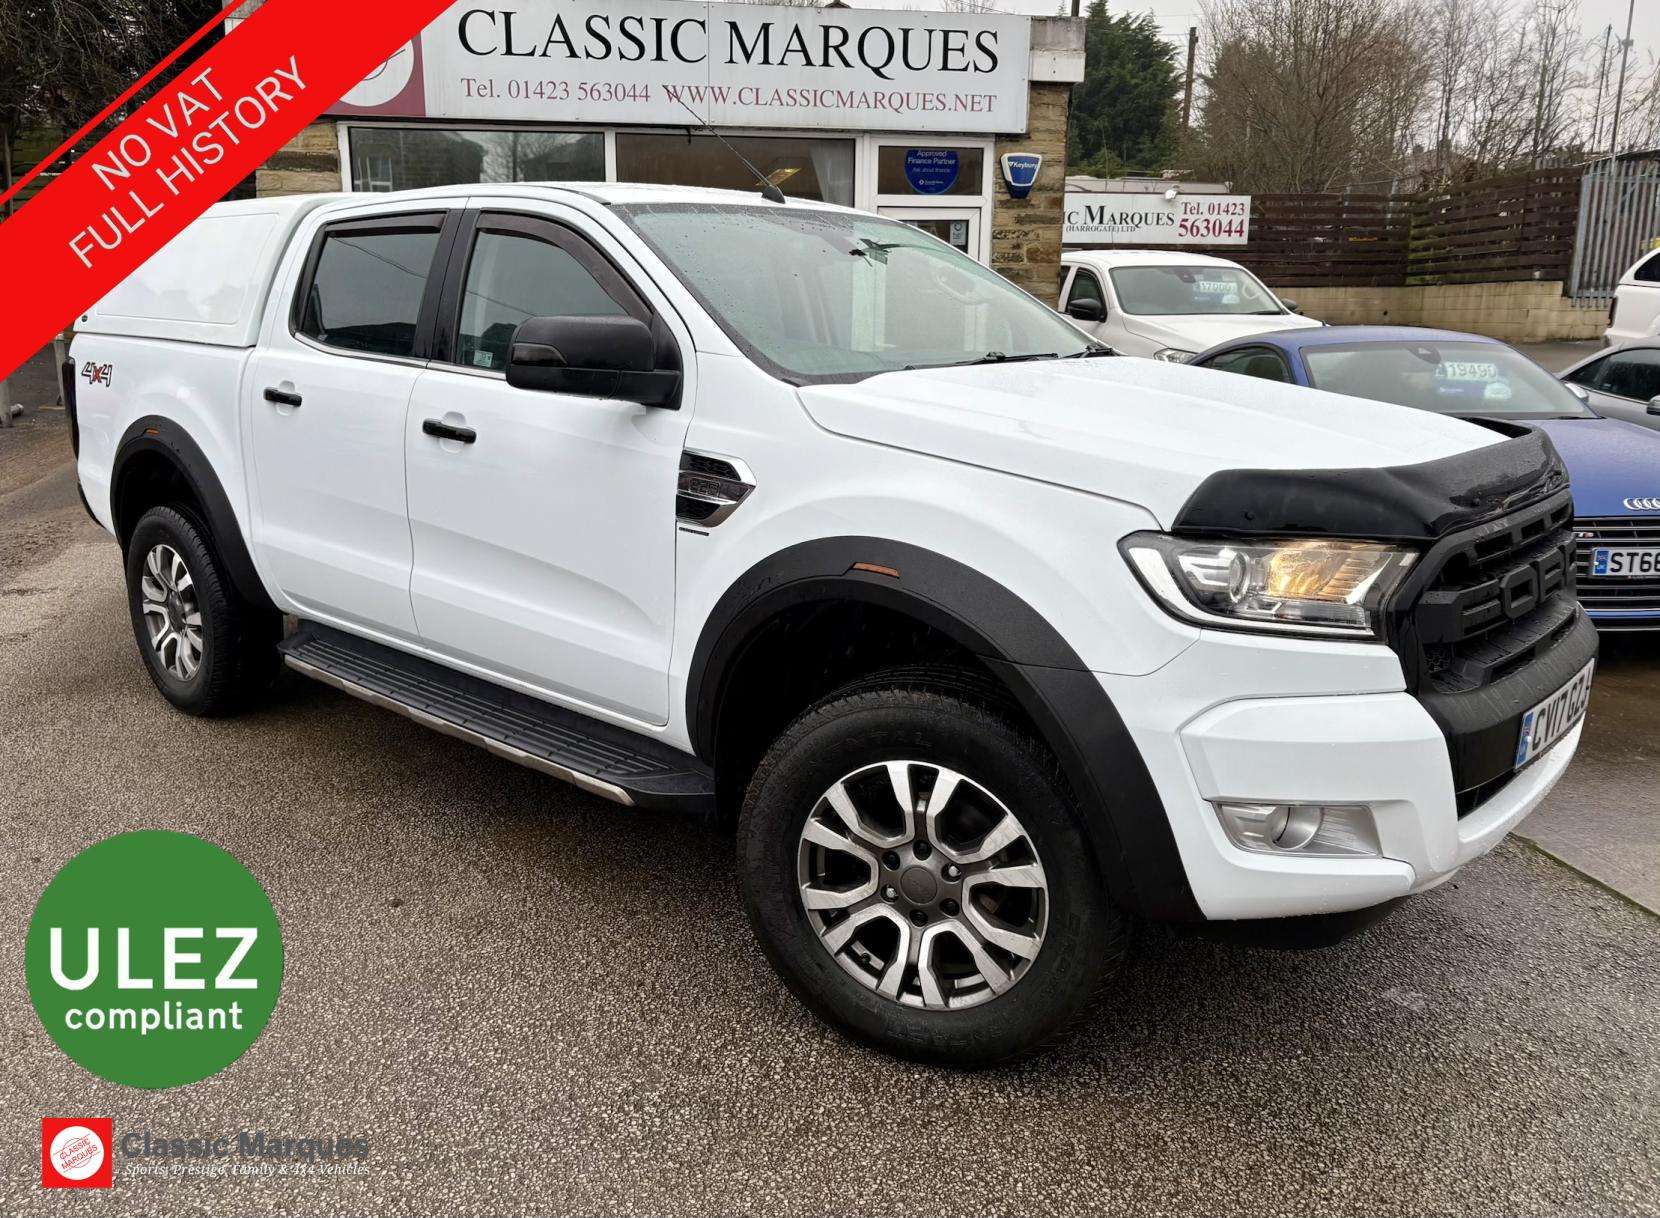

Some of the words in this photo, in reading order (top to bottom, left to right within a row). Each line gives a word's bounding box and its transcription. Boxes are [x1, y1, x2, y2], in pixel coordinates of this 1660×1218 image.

[458, 9, 707, 64] CLASSIC
[724, 20, 999, 80] MARQUES
[461, 78, 501, 98] Tel.
[508, 79, 570, 101] 01423
[577, 81, 651, 102] 563044
[664, 83, 998, 115] WWW.CLASSICMARQUES.NET
[907, 157, 933, 165] Finance
[933, 157, 957, 165] Partner
[916, 150, 948, 158] Approved
[1084, 205, 1175, 229] MARQUES
[1181, 201, 1203, 215] Tel.
[1207, 202, 1246, 216] 01423
[1065, 225, 1120, 233] (HARROGATE)
[1121, 225, 1137, 233] LTD
[1178, 218, 1245, 237] 563044
